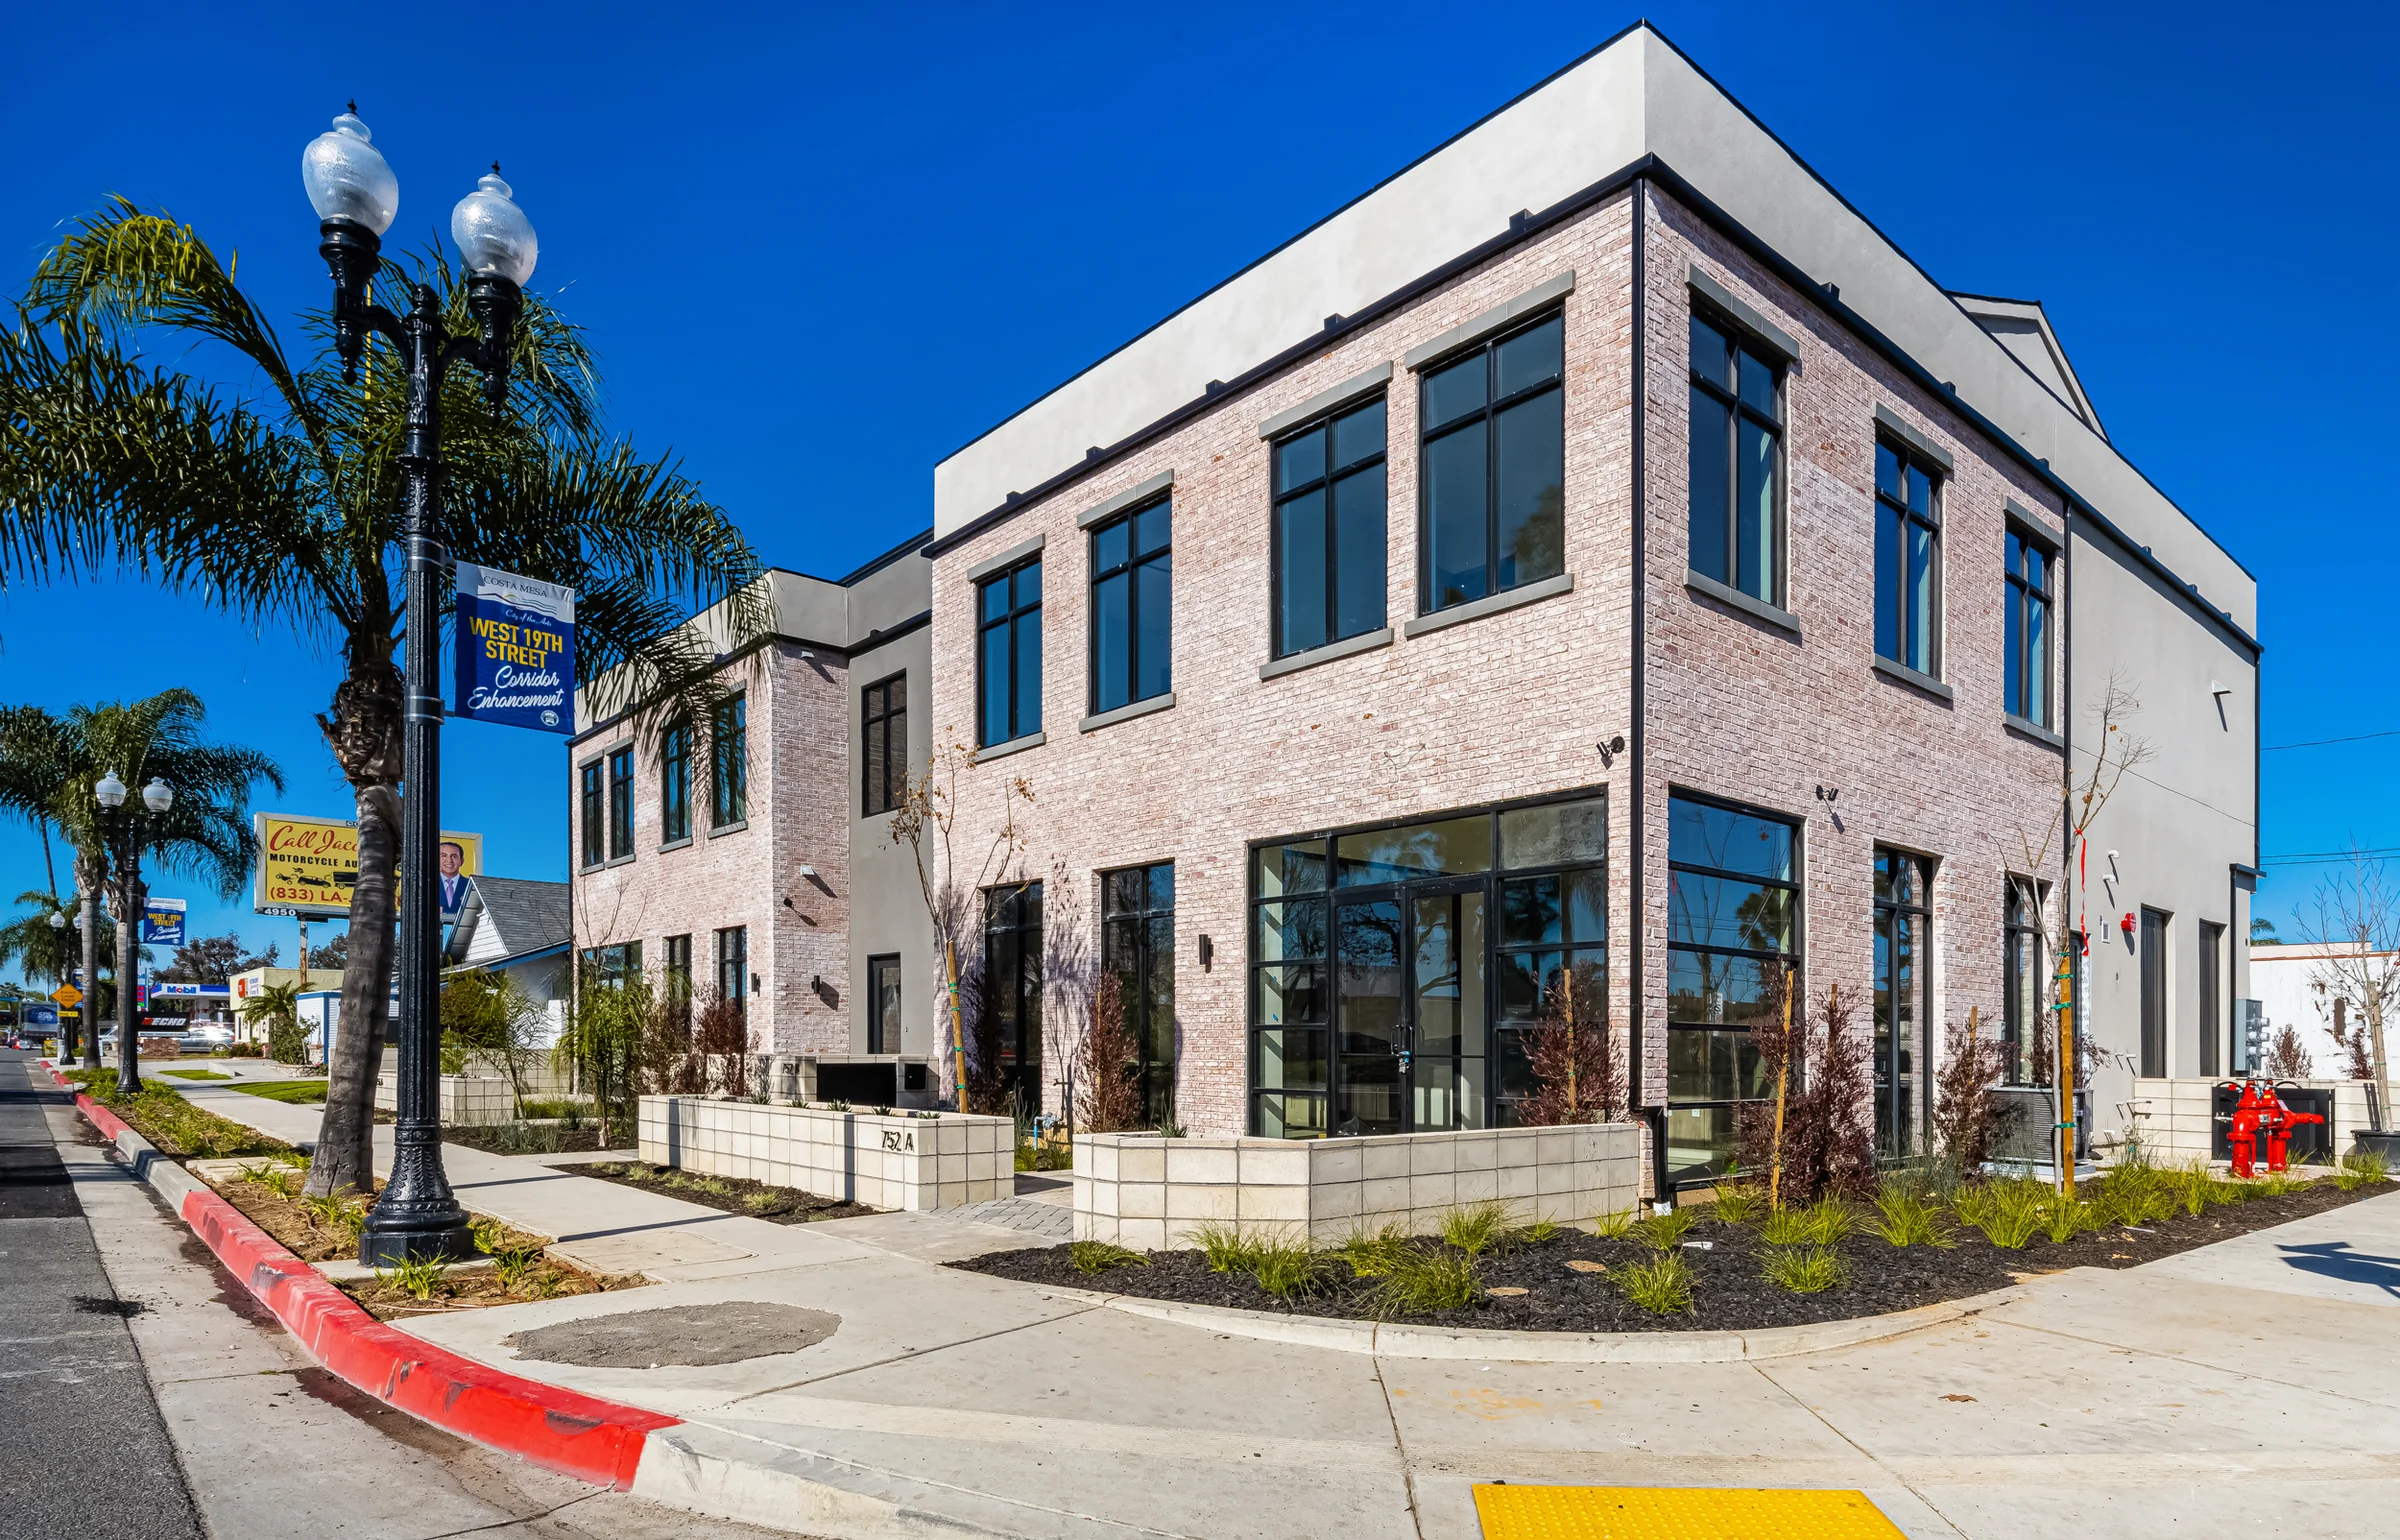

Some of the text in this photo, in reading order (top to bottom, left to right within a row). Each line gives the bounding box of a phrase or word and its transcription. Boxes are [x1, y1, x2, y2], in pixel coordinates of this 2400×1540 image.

[483, 575, 548, 598] COSTA MESA
[469, 616, 563, 653] WEST 19TH
[485, 639, 548, 668] STREET
[495, 665, 560, 689] Corridor
[467, 686, 565, 710] Enhancement
[269, 825, 318, 851] Call
[269, 853, 358, 868] MOTORCYCLE AU
[270, 887, 352, 903] (833) LA-
[147, 913, 166, 921] WEST
[264, 907, 297, 917] 4950
[167, 985, 197, 994] Mobil
[152, 1017, 187, 1026] ECHO
[881, 1130, 914, 1152] 752 A
